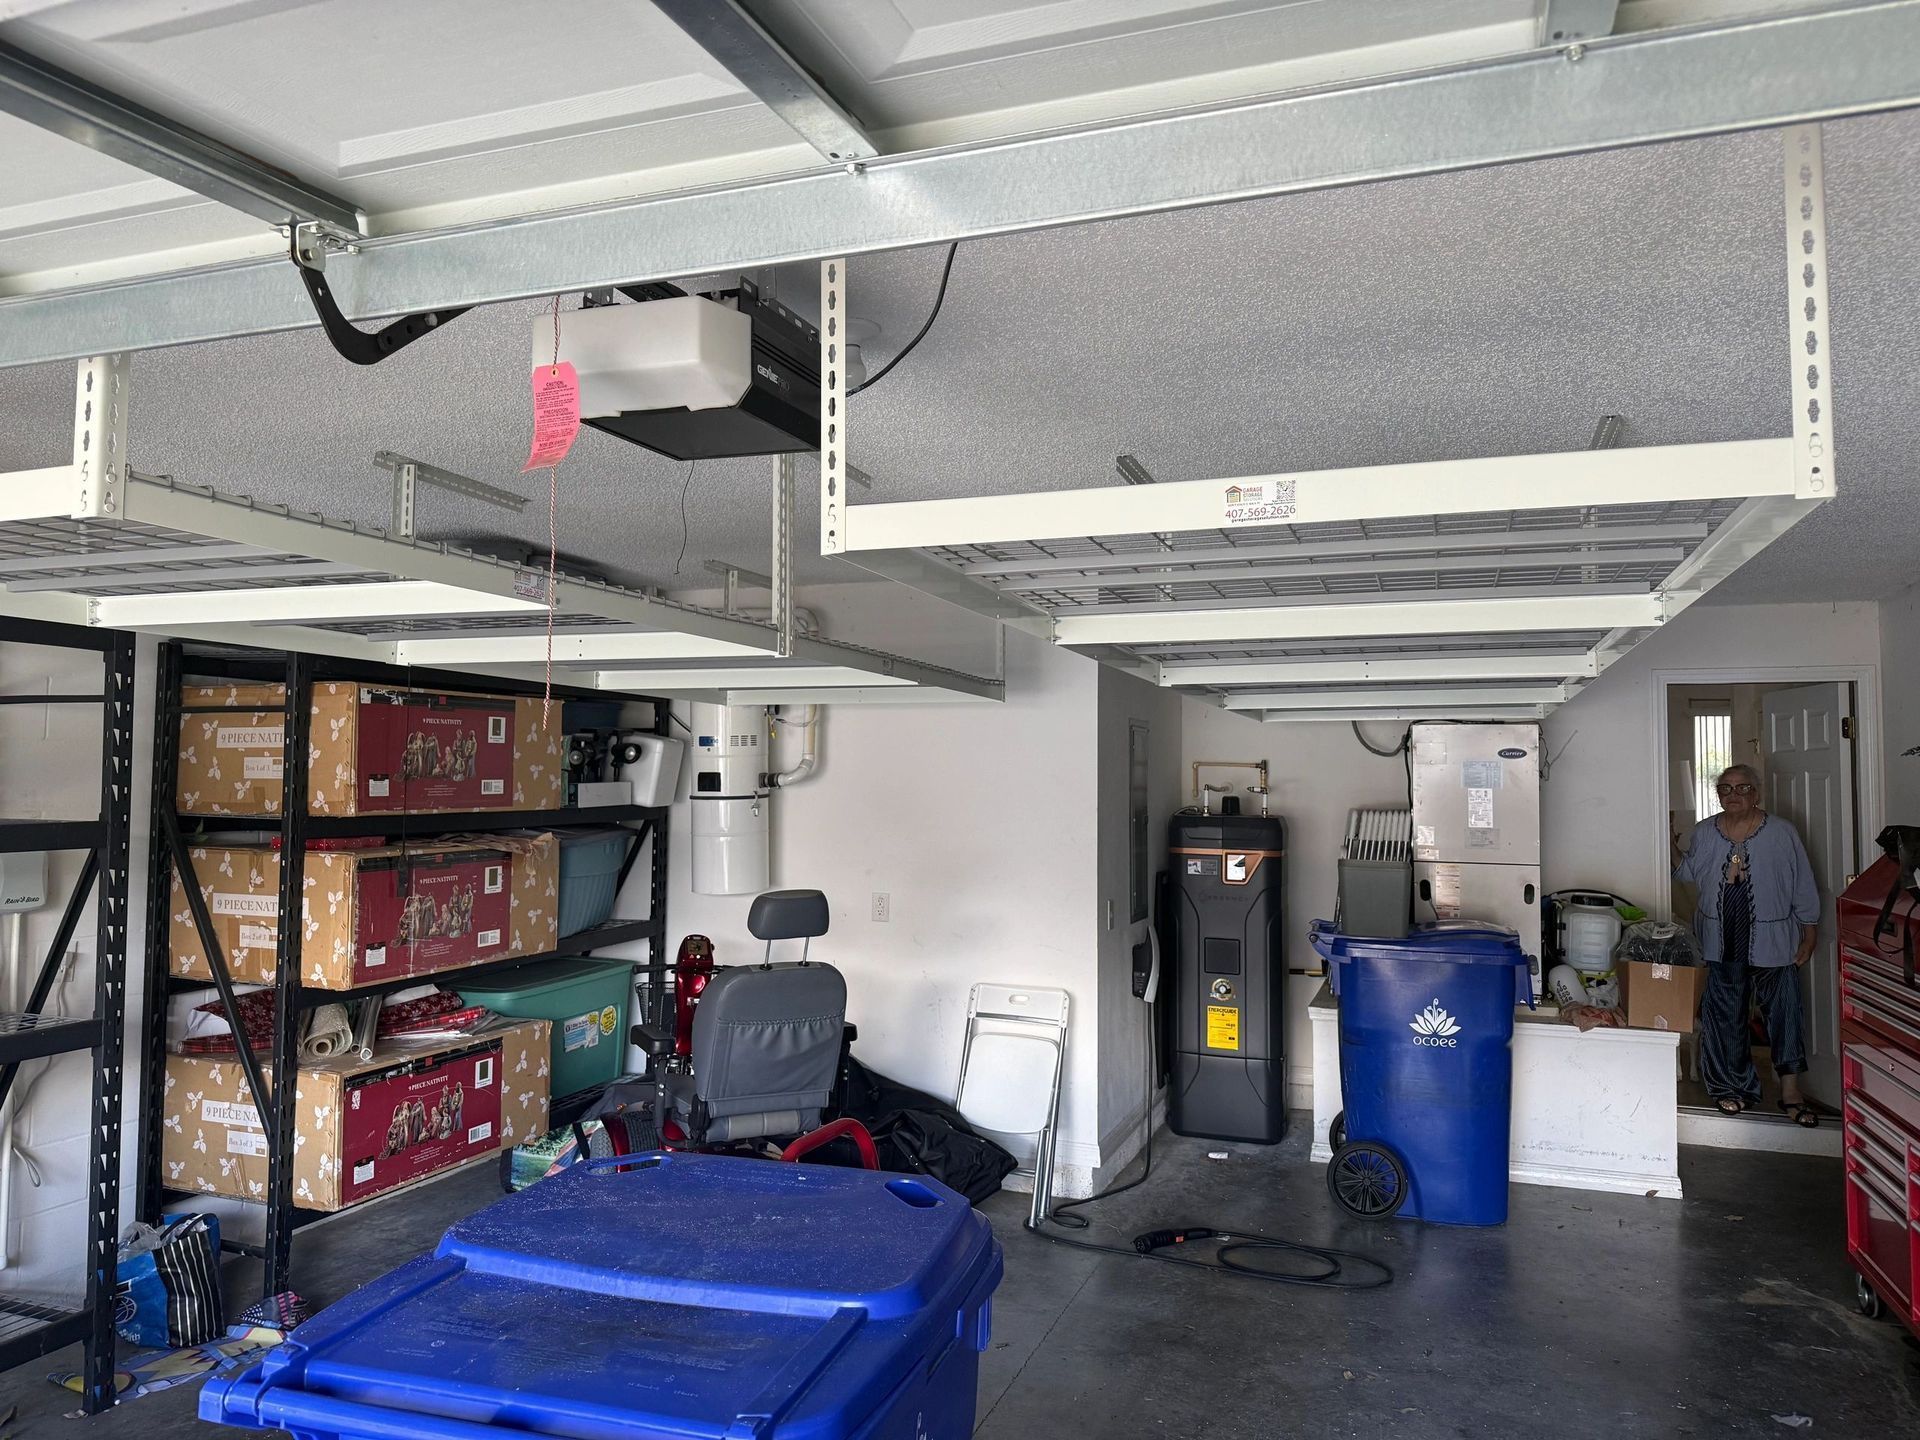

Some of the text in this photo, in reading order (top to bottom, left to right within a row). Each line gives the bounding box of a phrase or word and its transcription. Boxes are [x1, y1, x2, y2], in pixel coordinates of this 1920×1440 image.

[1225, 505, 1296, 518] 407-569-2626
[440, 718, 463, 726] NATIVITY
[221, 732, 283, 743] 9 PIECE NATI
[436, 875, 459, 883] NATIVITY
[217, 900, 222, 909] 9
[224, 899, 254, 911] PIECE
[411, 1081, 427, 1090] PIECE
[426, 1075, 449, 1087] NATIVITY
[206, 1106, 211, 1116] 9
[213, 1107, 241, 1120] PIECE
